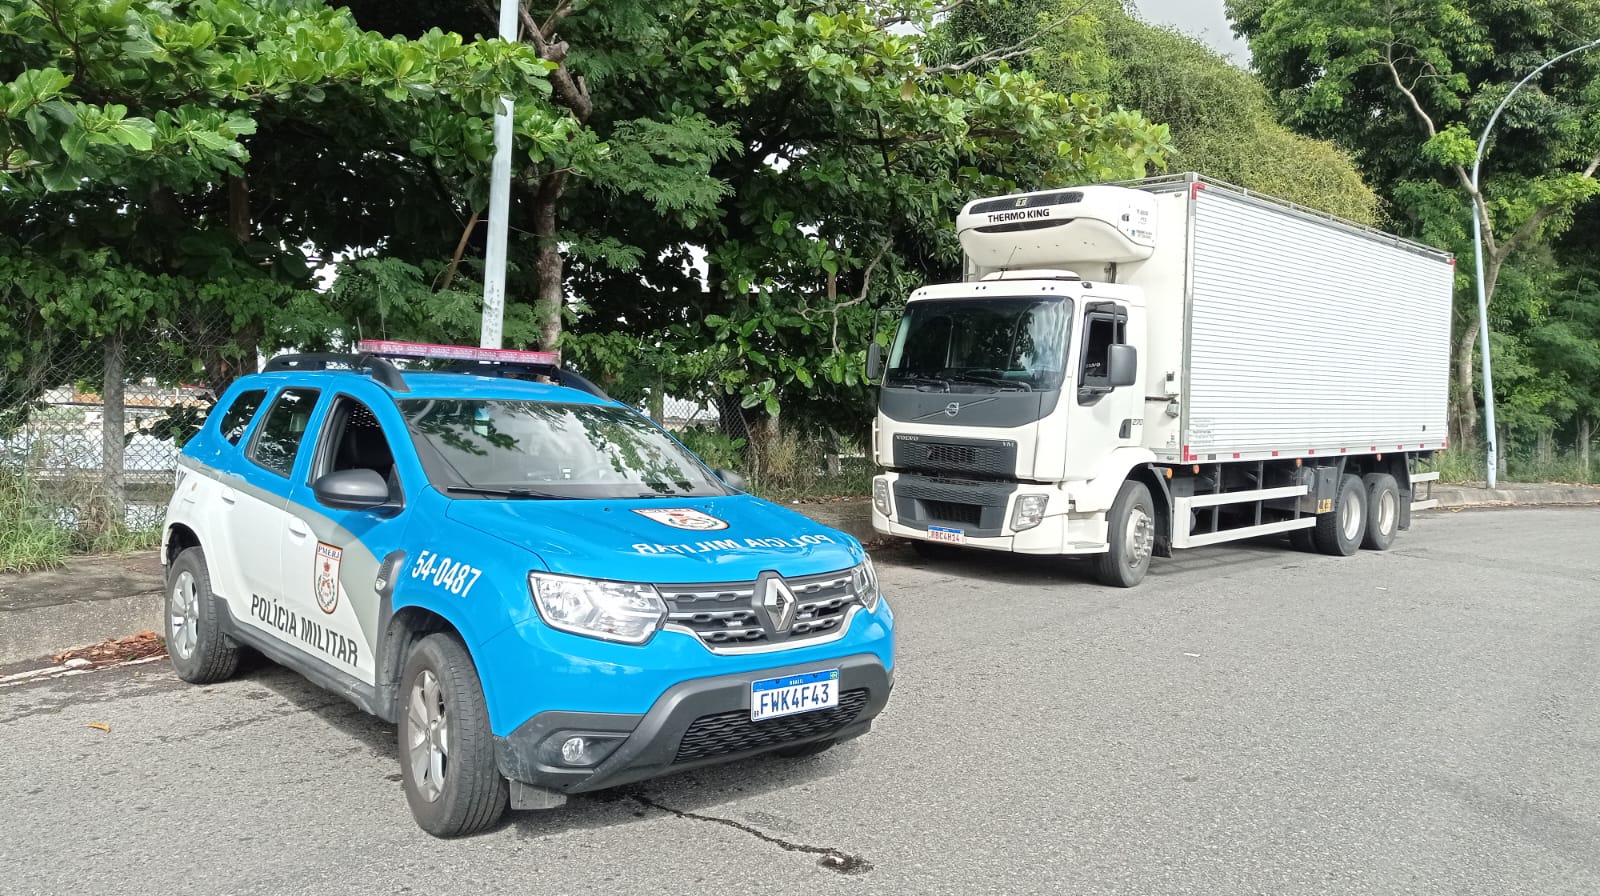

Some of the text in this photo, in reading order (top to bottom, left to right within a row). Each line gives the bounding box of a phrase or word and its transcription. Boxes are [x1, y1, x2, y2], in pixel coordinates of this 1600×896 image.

[988, 208, 1050, 223] THERMO KING
[318, 545, 340, 559] PMERJ
[411, 549, 483, 599] 54-0487
[250, 593, 358, 668] POLÍCIA MILITAR
[760, 683, 830, 715] FWK4F43
